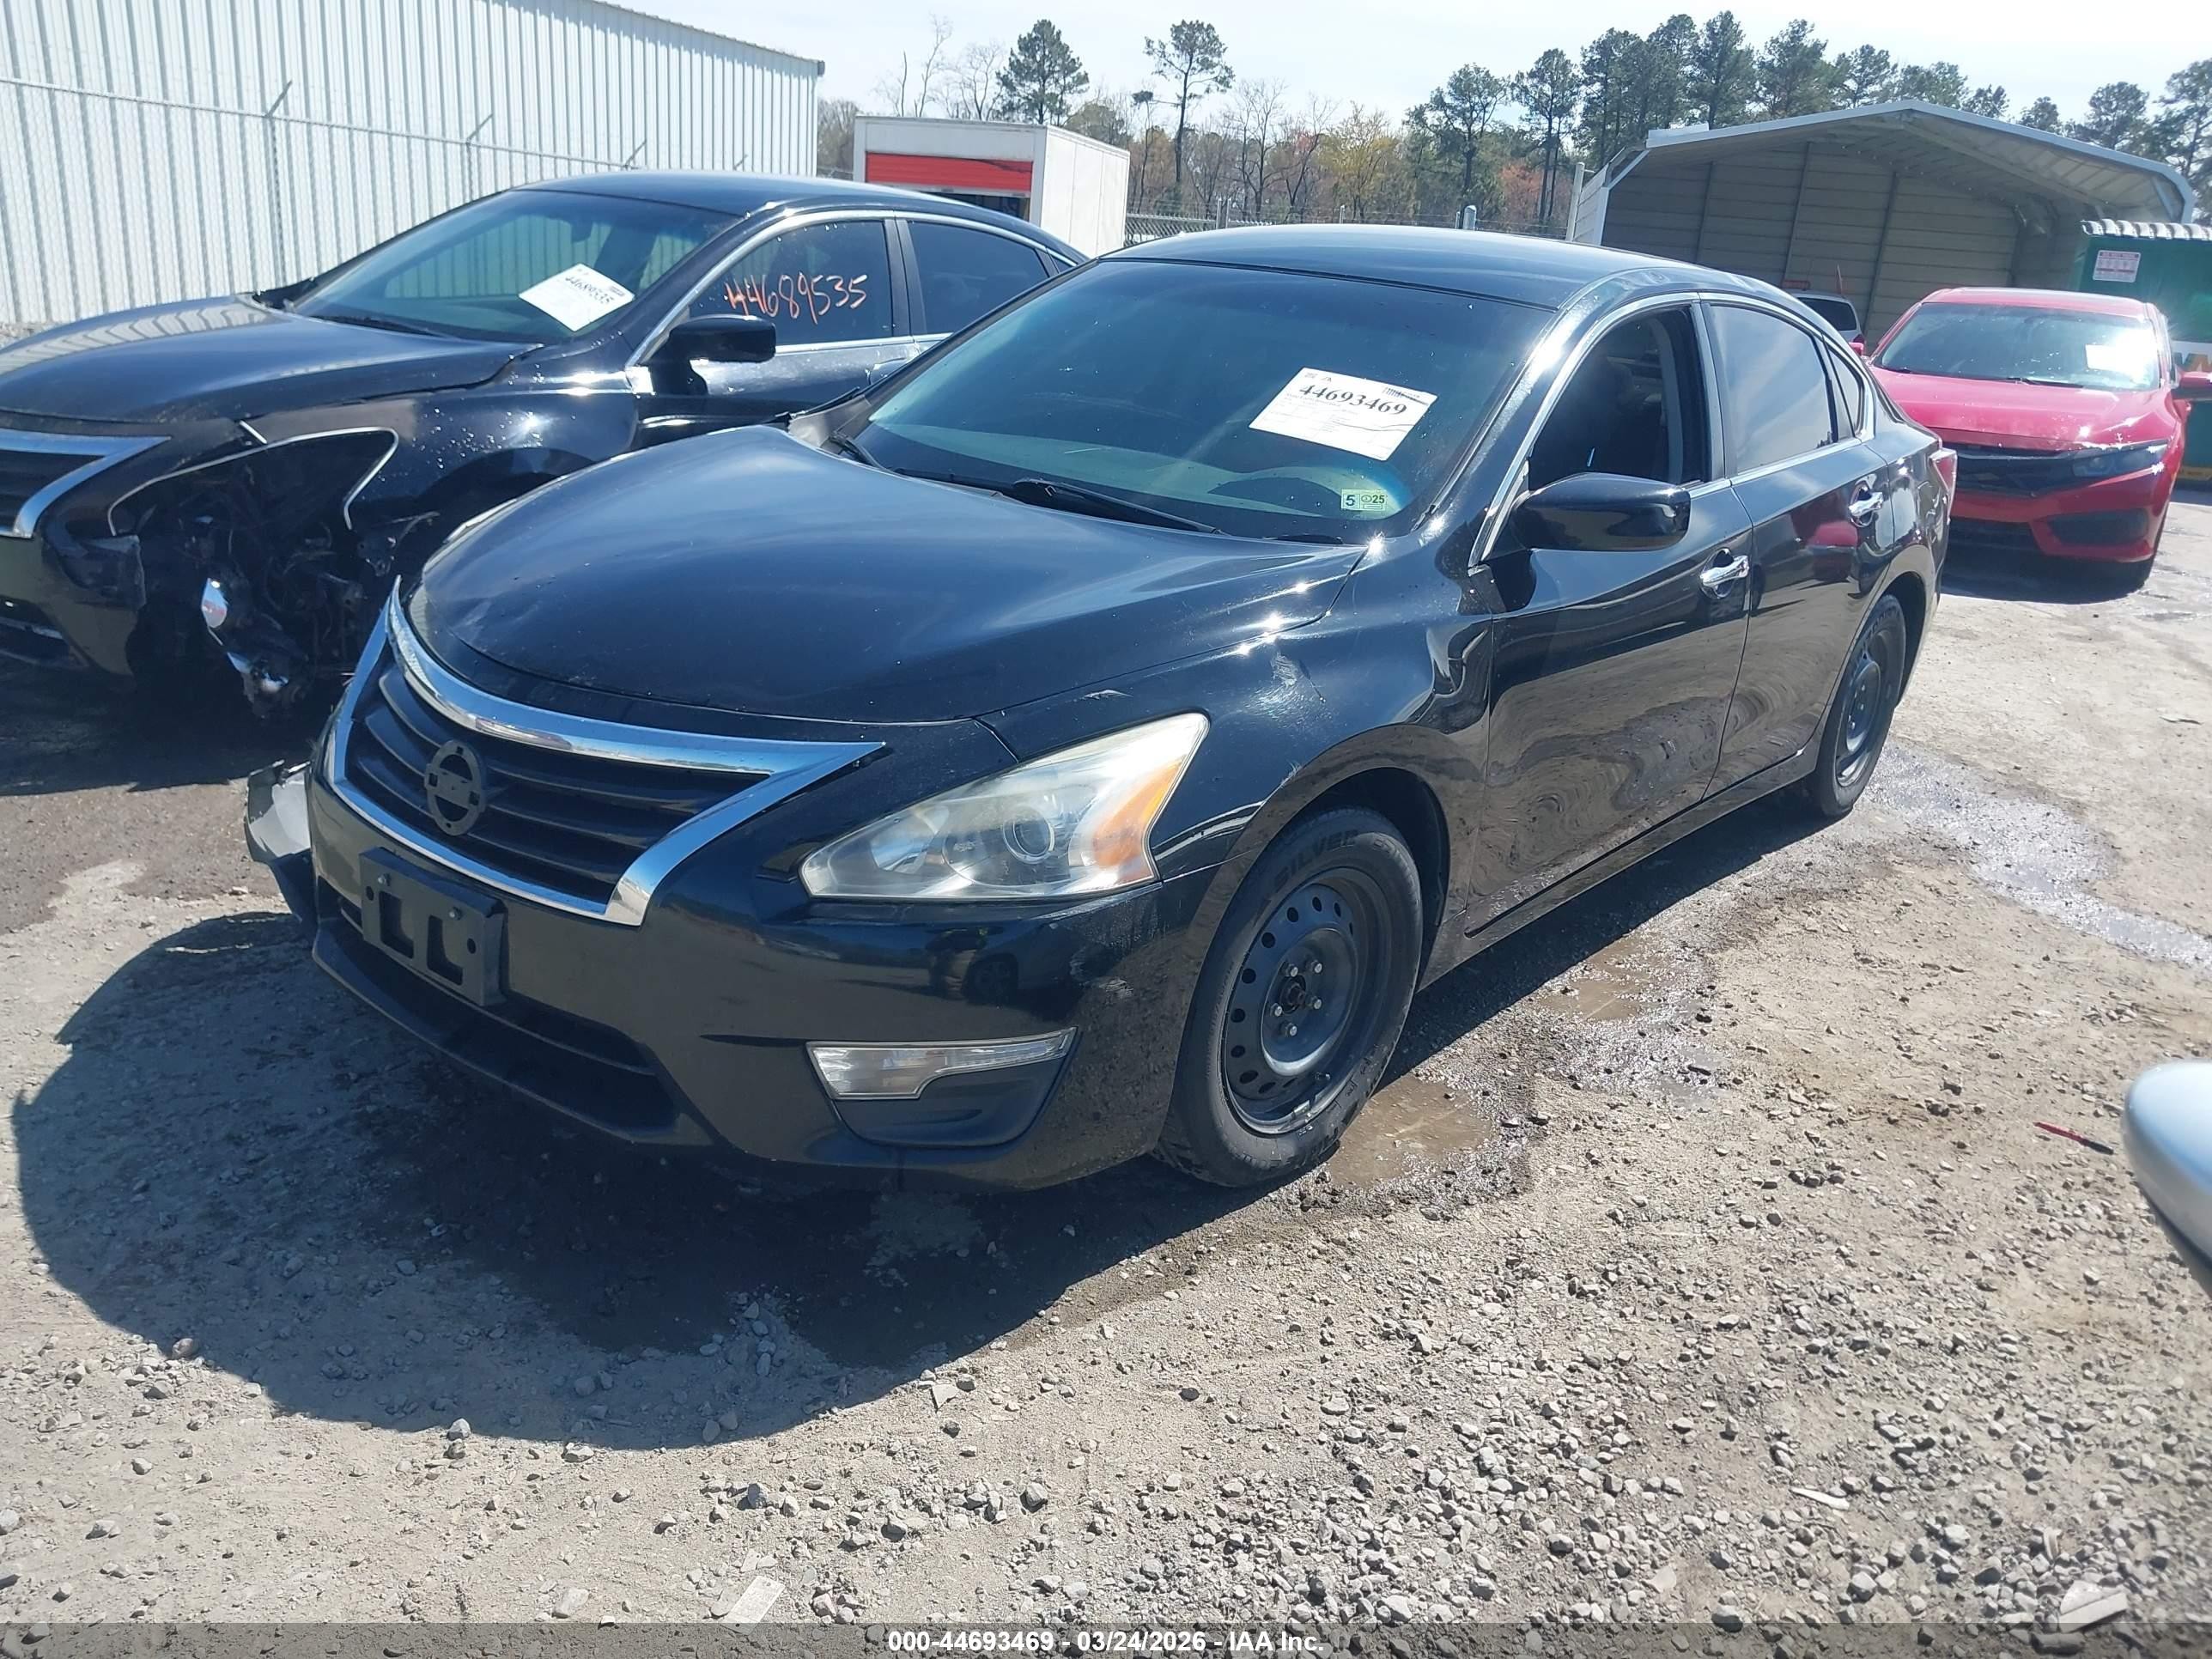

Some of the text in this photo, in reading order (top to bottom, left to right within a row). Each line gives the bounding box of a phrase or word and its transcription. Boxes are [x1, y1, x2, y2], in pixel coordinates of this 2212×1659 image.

[724, 271, 868, 325] 44689535
[1299, 385, 1407, 415] 44693469
[1345, 494, 1385, 507] 5 25
